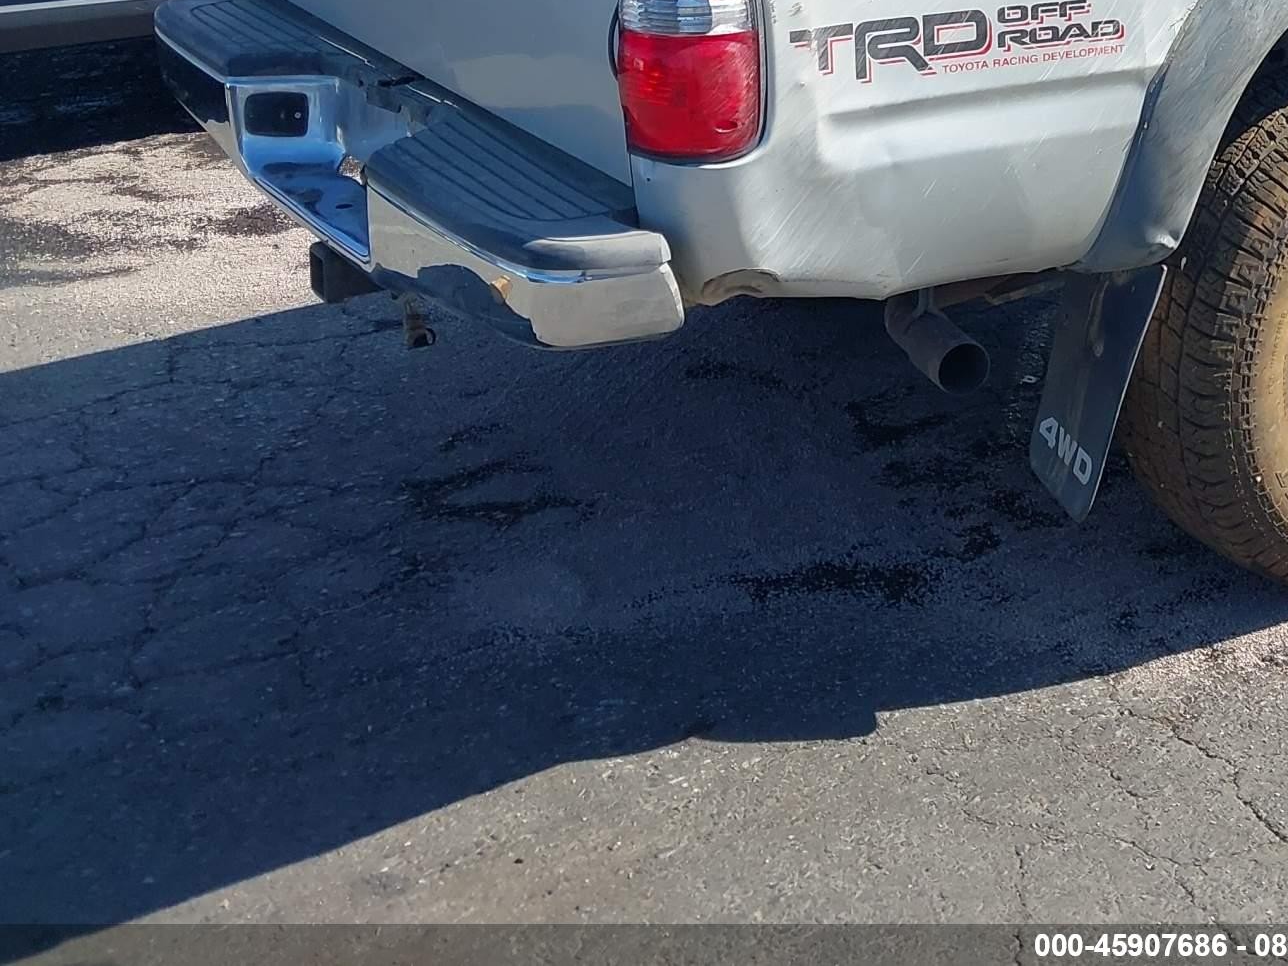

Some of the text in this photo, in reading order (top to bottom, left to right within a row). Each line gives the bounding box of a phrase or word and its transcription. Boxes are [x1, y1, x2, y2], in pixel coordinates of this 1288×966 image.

[789, 8, 993, 84] TRD
[941, 44, 1127, 74] TOYOTA RACING DEVELOPMENT
[997, 18, 1125, 52] ROAD
[1039, 417, 1093, 485] 4WD
